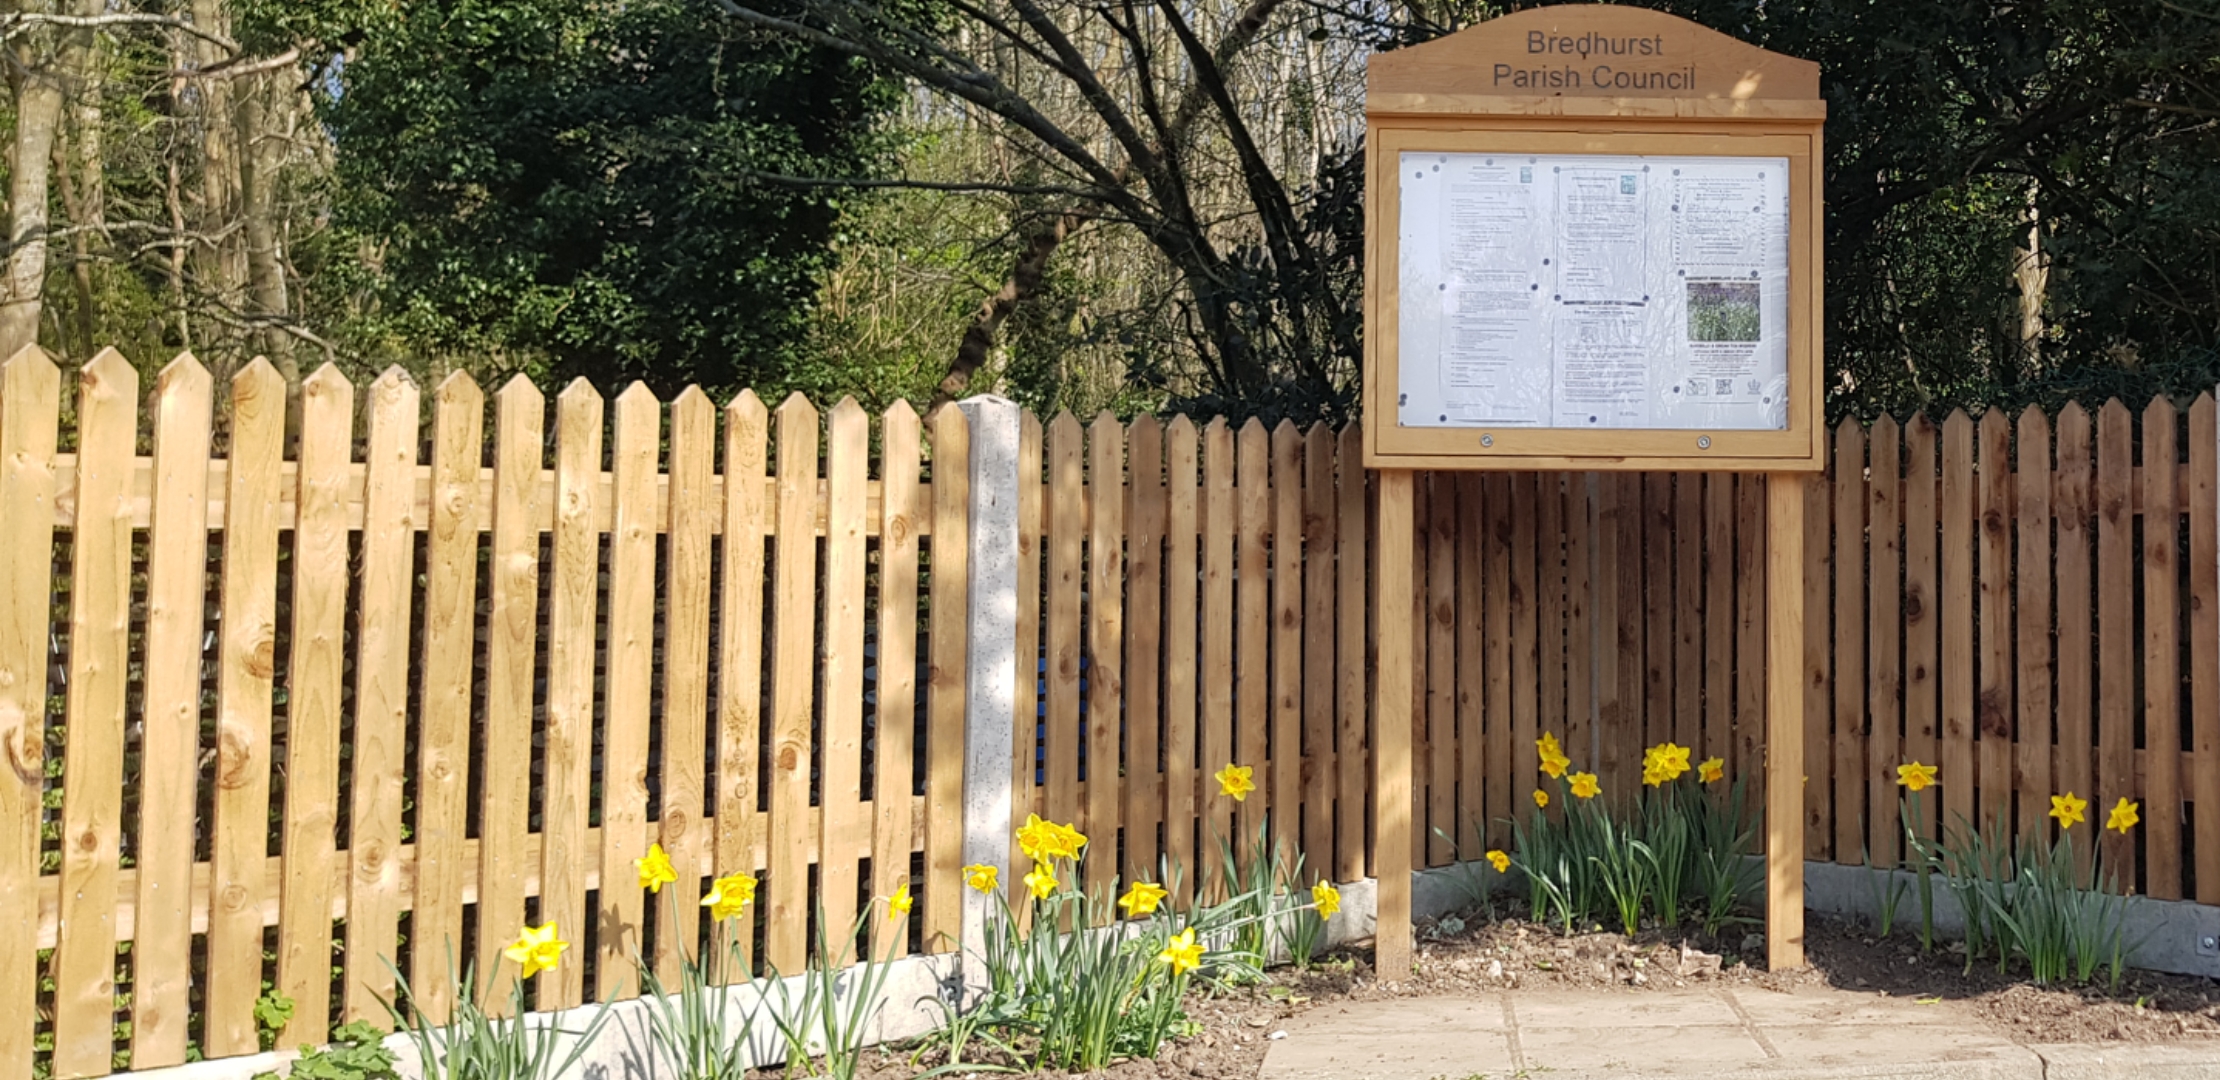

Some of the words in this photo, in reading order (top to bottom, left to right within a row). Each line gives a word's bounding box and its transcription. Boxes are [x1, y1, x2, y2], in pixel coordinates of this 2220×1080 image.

[1527, 30, 1663, 56] Bredhurst
[1493, 63, 1581, 88] Parish
[1592, 65, 1696, 90] Council
